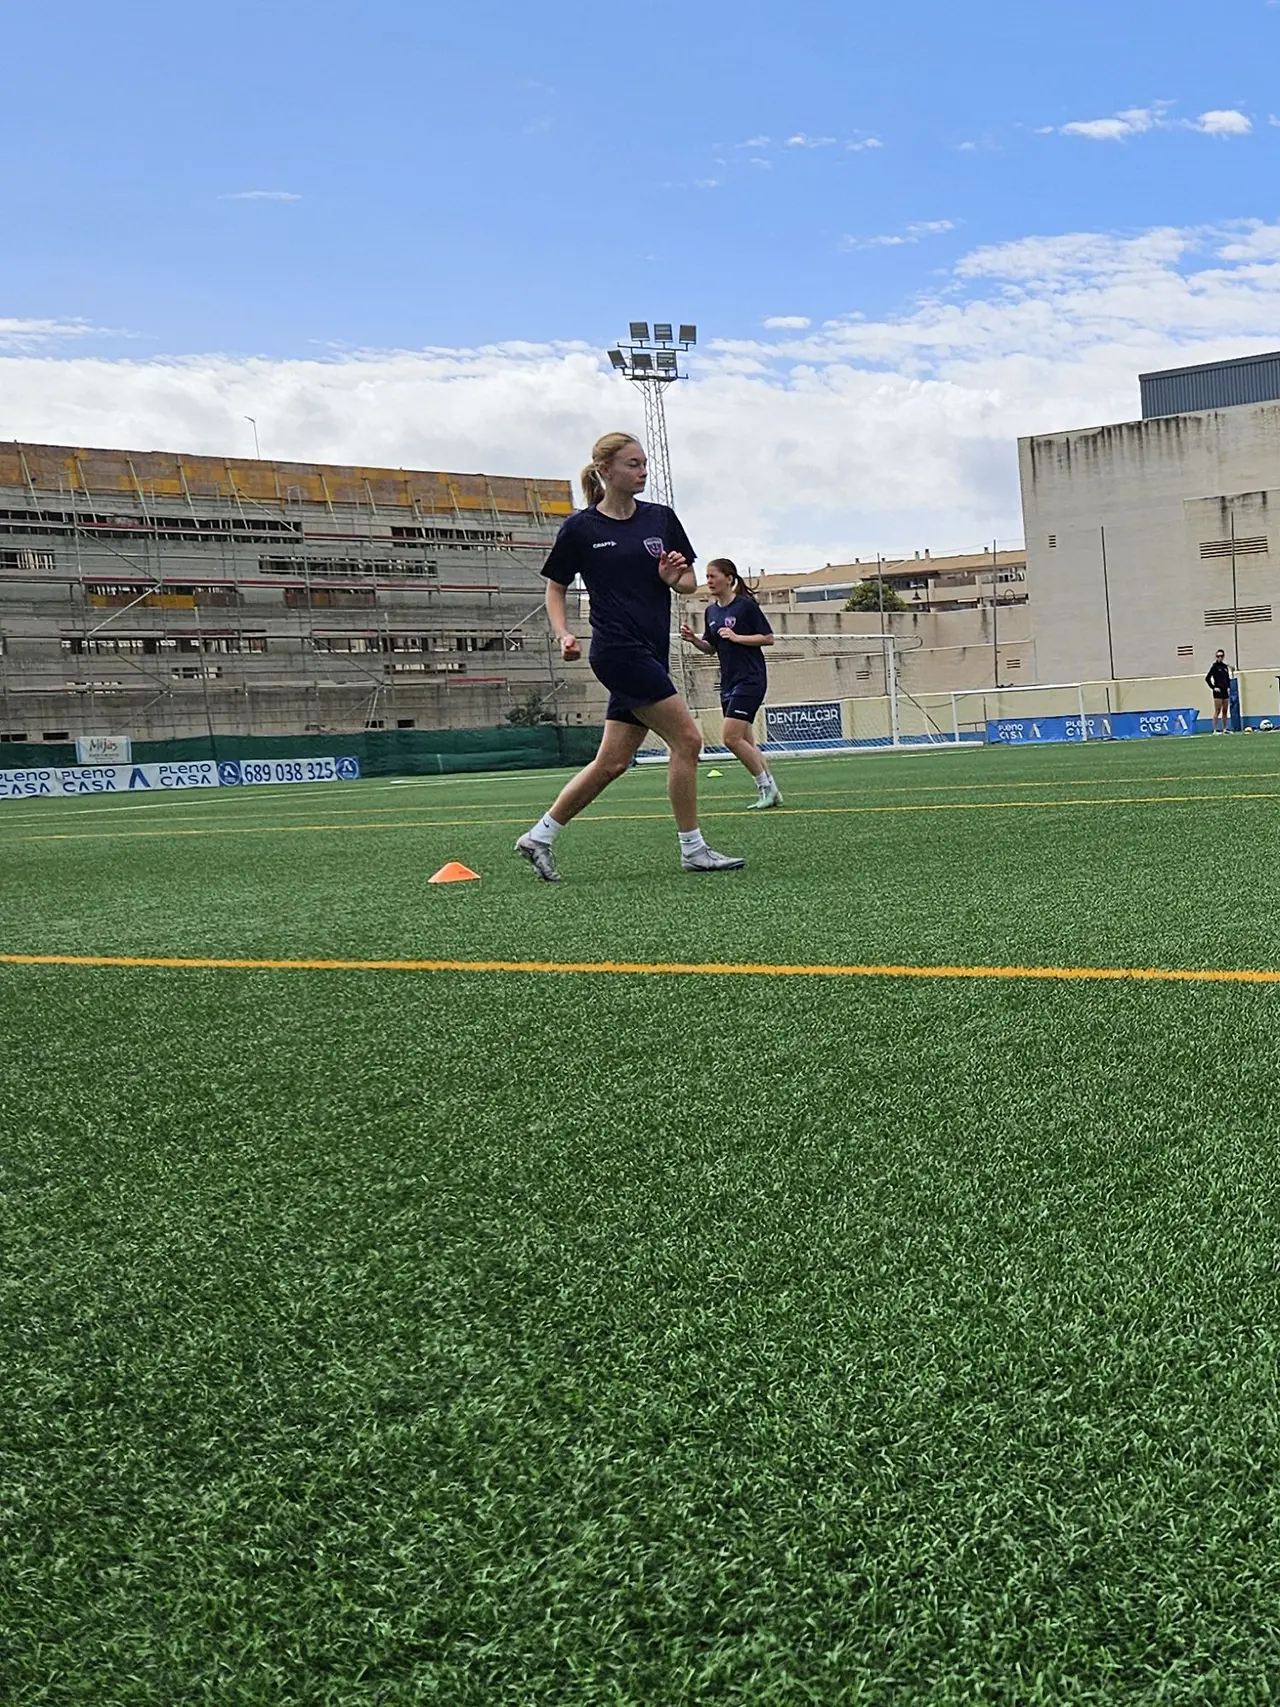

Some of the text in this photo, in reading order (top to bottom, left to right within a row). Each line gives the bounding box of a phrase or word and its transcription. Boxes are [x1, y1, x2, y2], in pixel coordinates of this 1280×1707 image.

[244, 761, 334, 782] 689 038 325
[63, 780, 116, 793] CASA
[161, 774, 211, 787] CASA
